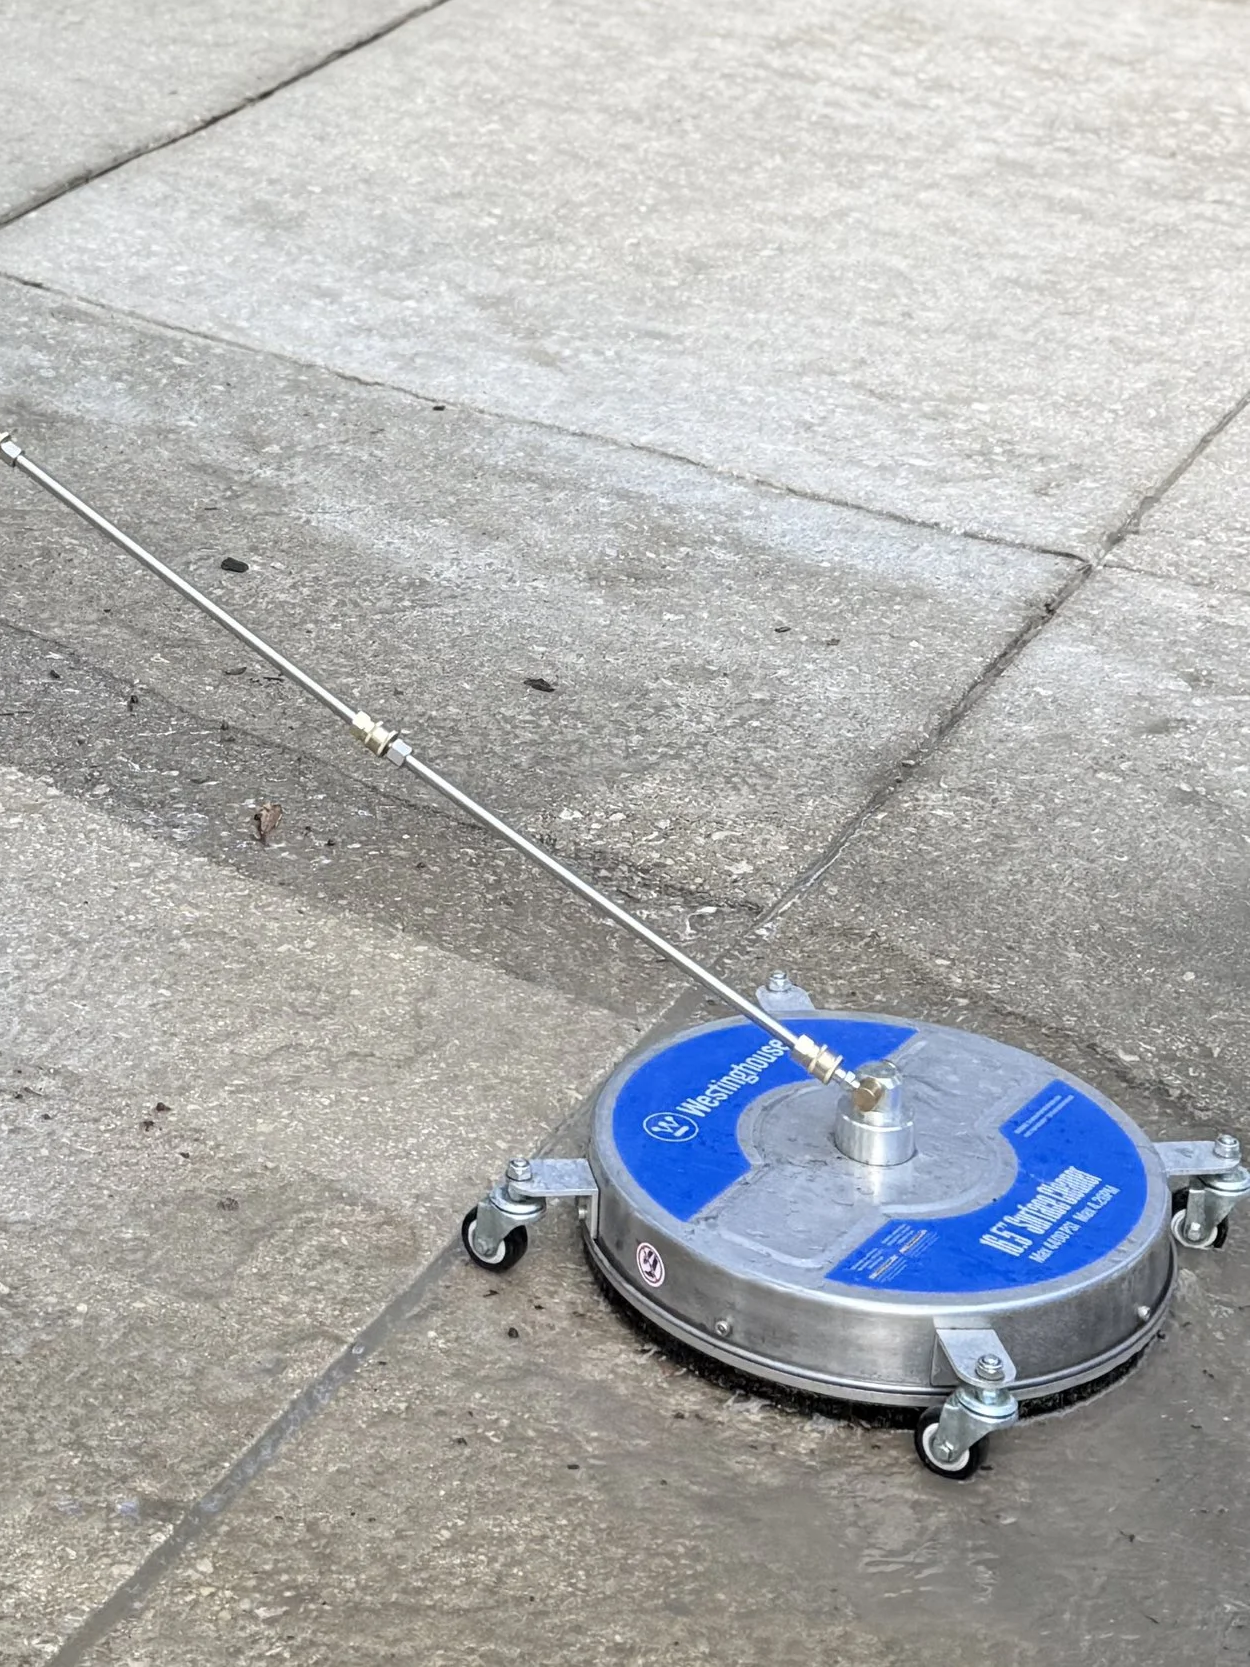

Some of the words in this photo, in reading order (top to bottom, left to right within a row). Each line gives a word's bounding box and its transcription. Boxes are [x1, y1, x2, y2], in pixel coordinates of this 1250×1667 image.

[676, 1038, 791, 1118] Westinghouse
[1036, 1166, 1103, 1205] Cleaner
[1003, 1194, 1072, 1235] Surface
[1029, 1246, 1054, 1264] Max
[1058, 1221, 1082, 1235] PSI
[1072, 1207, 1097, 1223] Max
